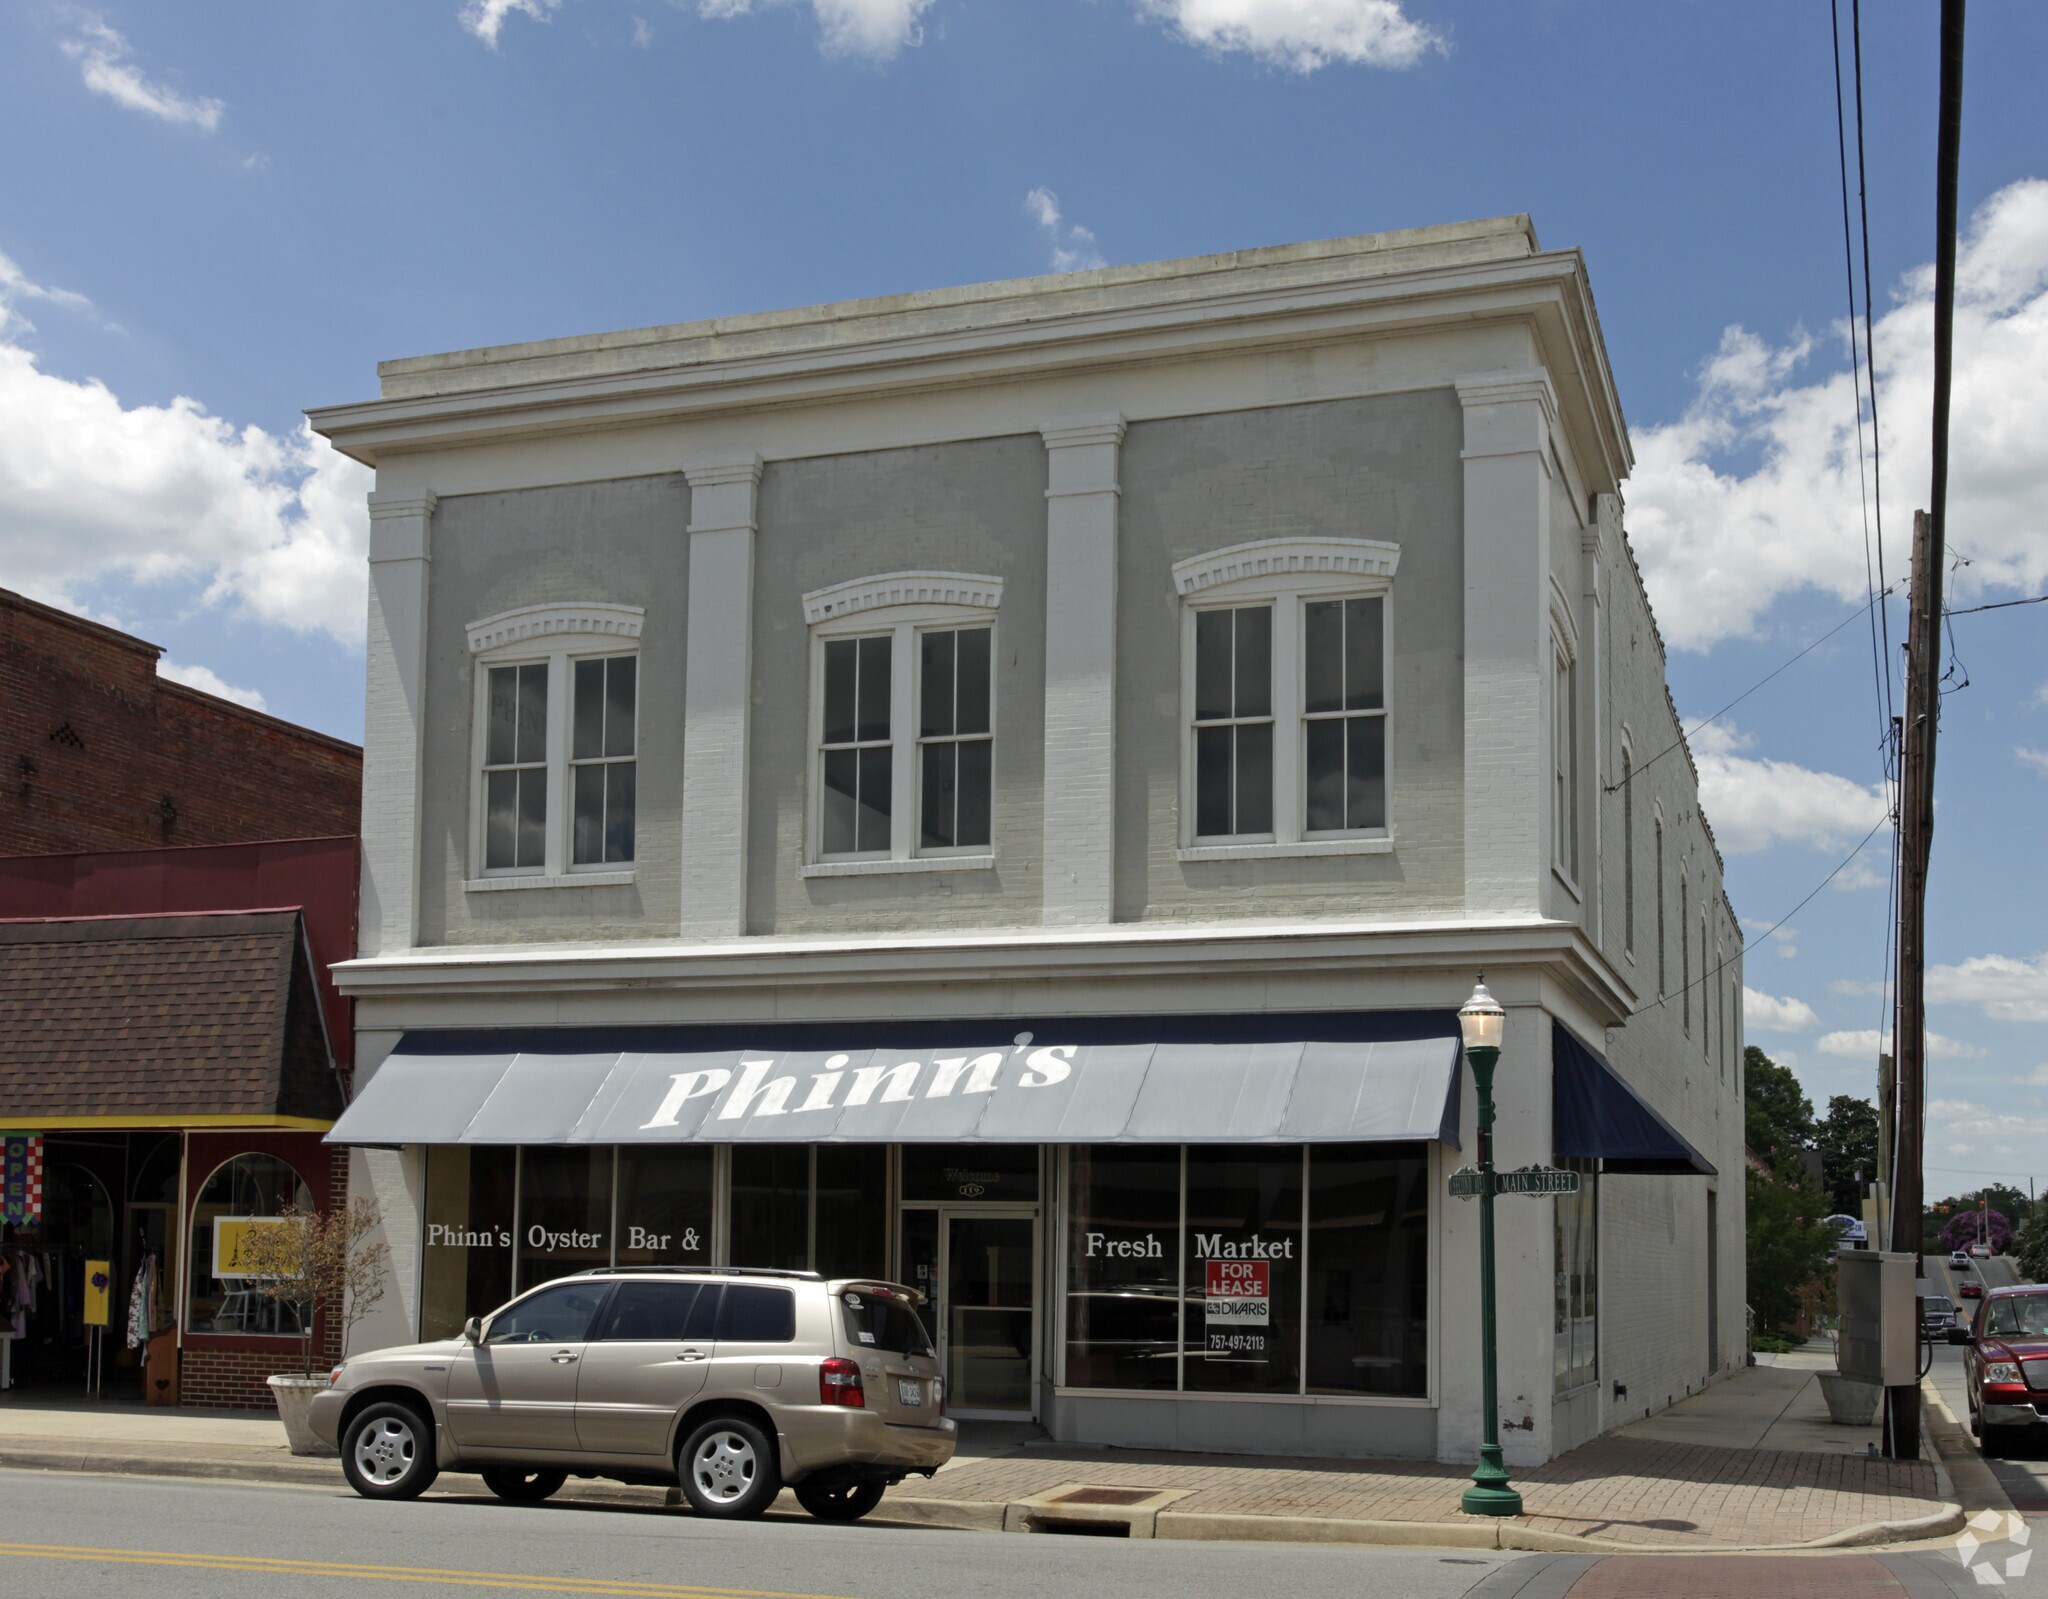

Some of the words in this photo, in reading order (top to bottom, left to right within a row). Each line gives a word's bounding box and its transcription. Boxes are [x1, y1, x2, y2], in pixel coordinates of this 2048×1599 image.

[639, 1031, 1078, 1130] Phinn's
[8, 1142, 25, 1216] OPEN
[943, 1168, 1000, 1182] Welcome
[1502, 1174, 1529, 1192] MAIN
[1535, 1173, 1573, 1191] STREET
[427, 1224, 511, 1247] Phinn's
[528, 1225, 602, 1252] Oyster
[628, 1226, 671, 1250] Bar
[681, 1227, 700, 1250] &
[1085, 1232, 1163, 1258] Fresh
[1194, 1233, 1293, 1259] Market
[1221, 1263, 1253, 1278] FOR
[1212, 1280, 1262, 1295] LEASE
[1221, 1302, 1267, 1315] DIVARIS
[1210, 1335, 1264, 1350] 757-497-2113
